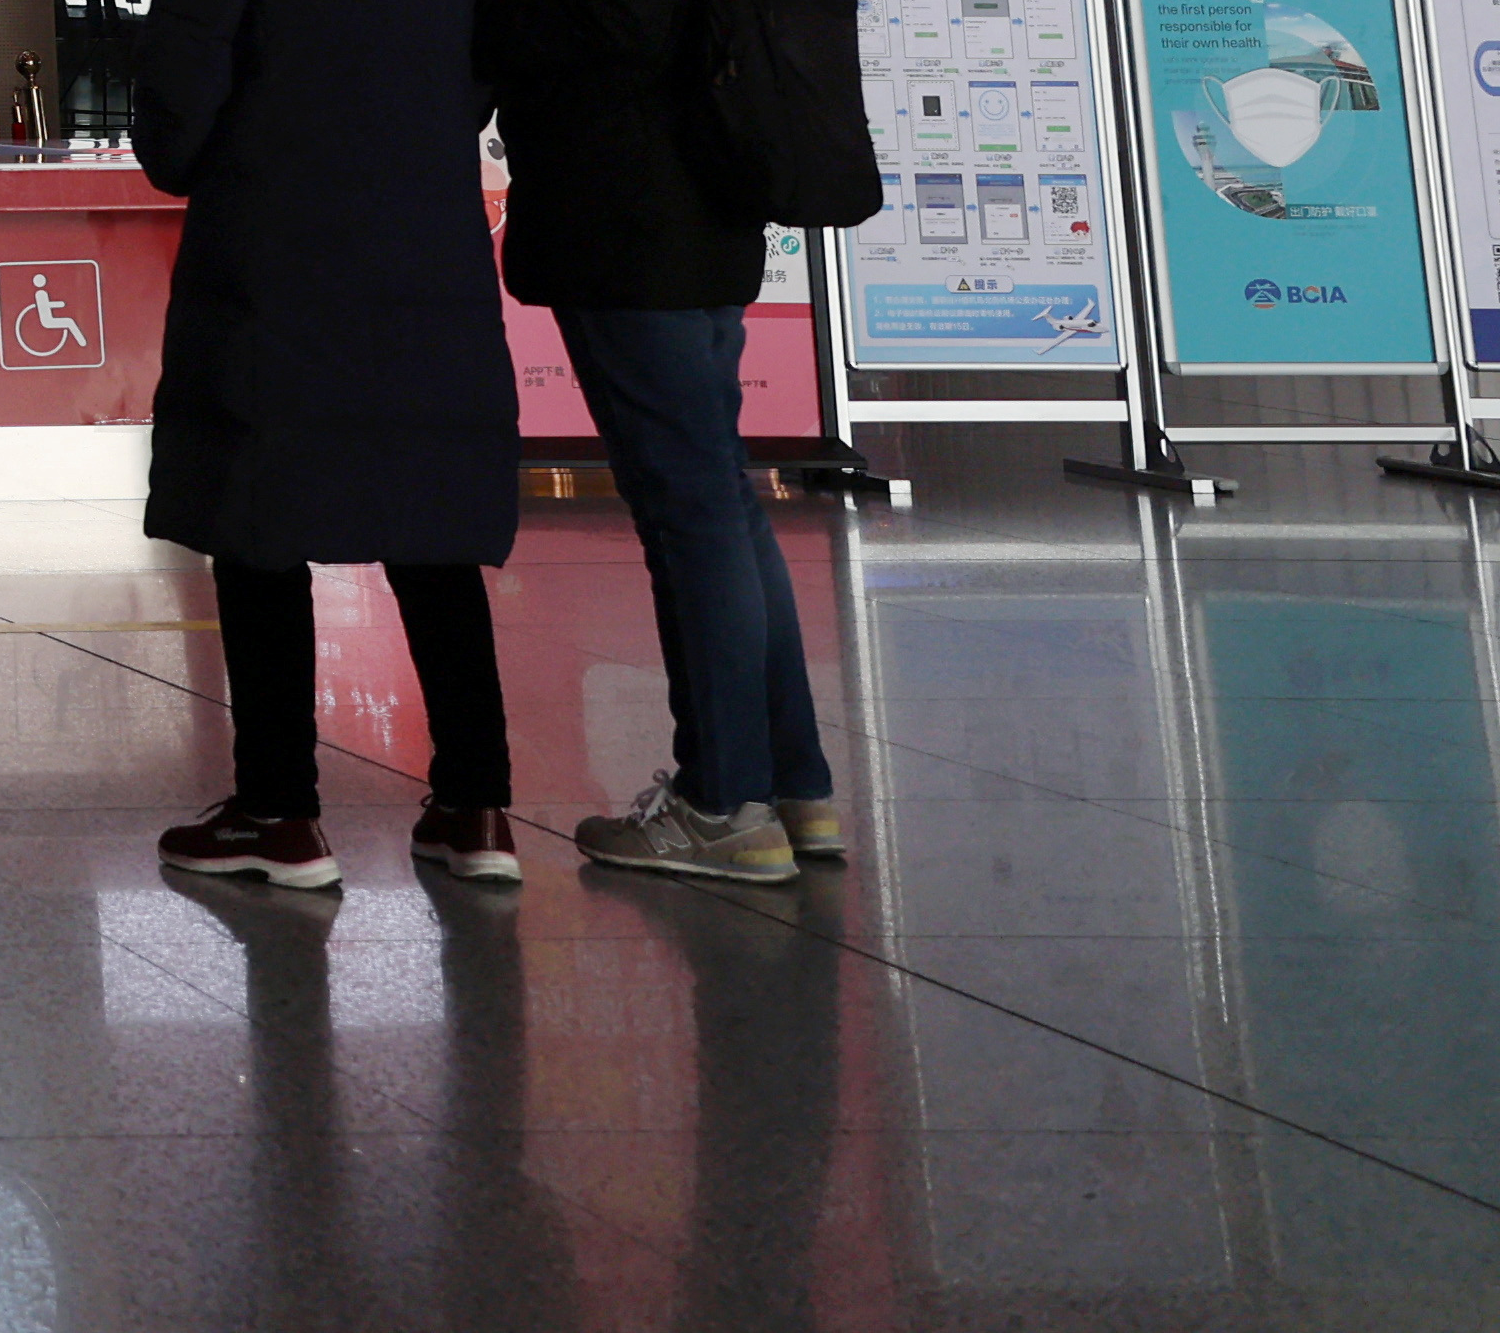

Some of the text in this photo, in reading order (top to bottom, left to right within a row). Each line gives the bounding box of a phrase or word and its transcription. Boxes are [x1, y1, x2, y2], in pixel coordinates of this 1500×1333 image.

[1158, 3, 1252, 19] the first person
[1160, 20, 1252, 34] responsible for
[1162, 37, 1261, 49] their own health
[1290, 206, 1332, 217] 出门防护
[1287, 286, 1347, 303] BCIA
